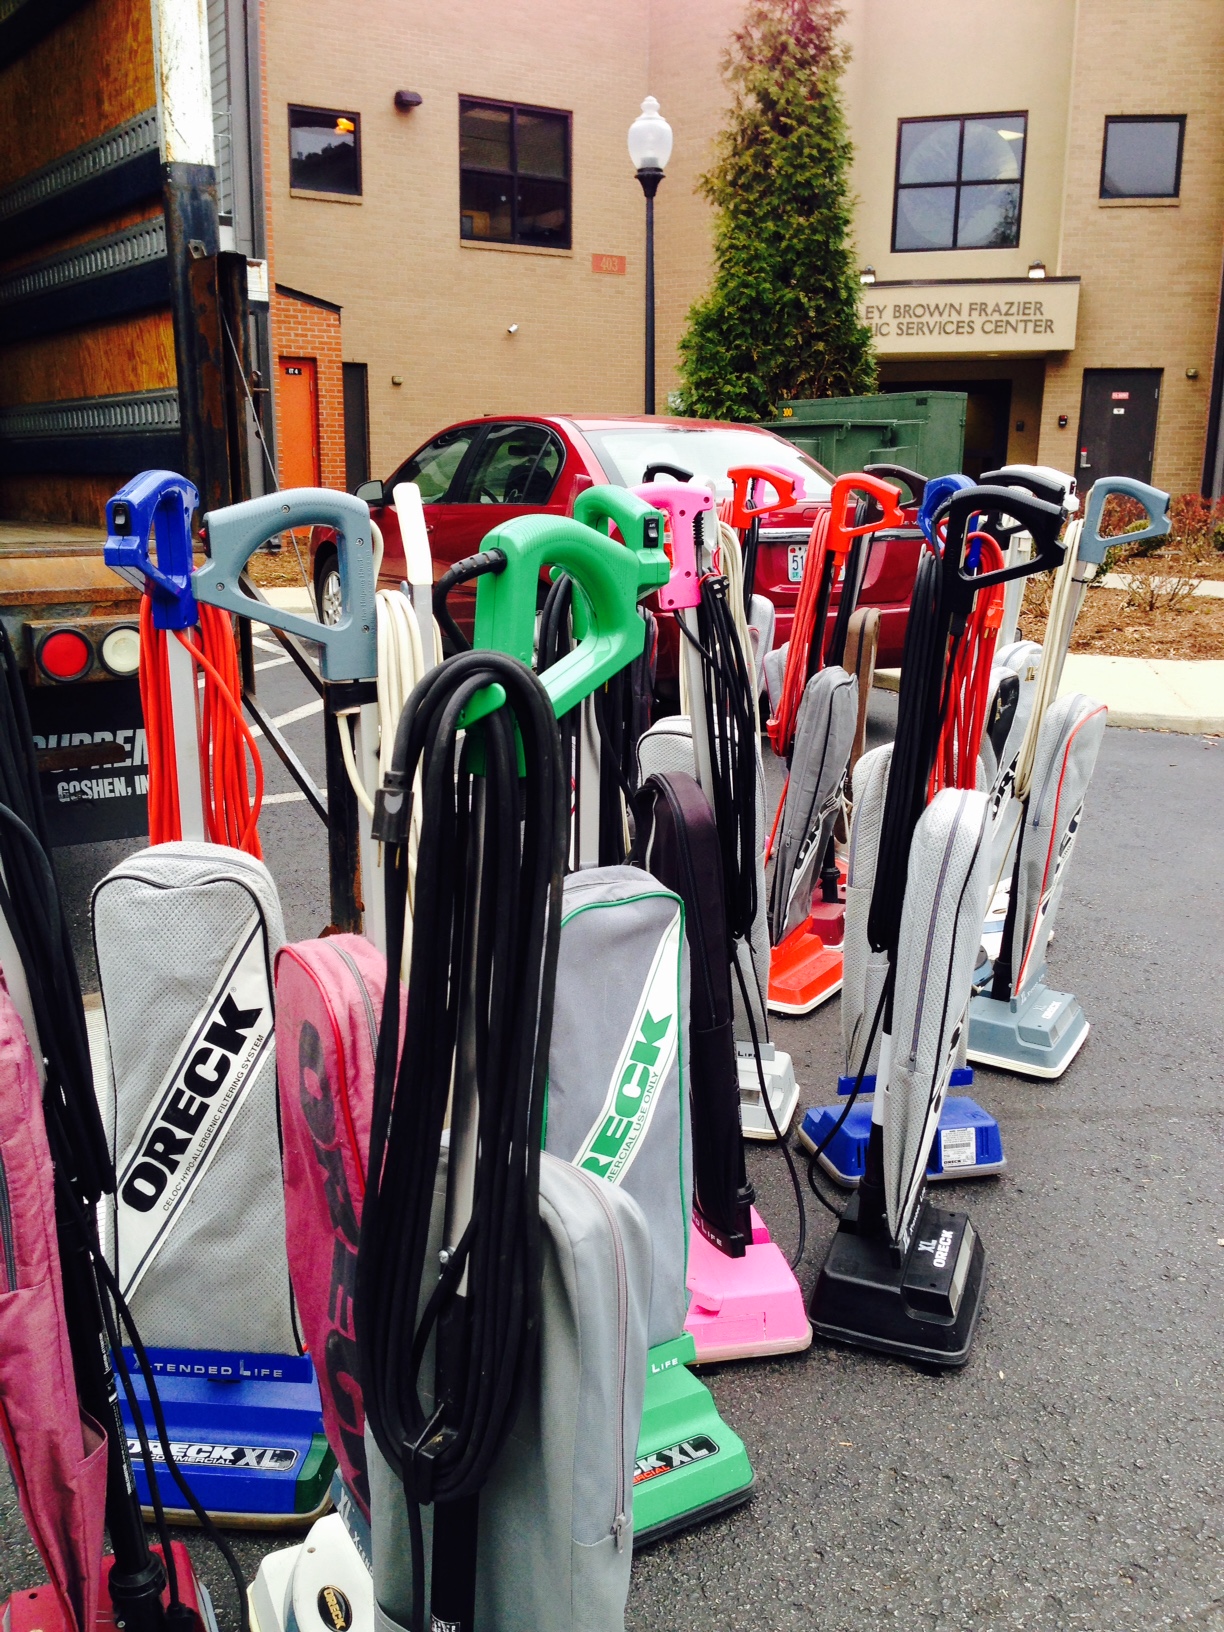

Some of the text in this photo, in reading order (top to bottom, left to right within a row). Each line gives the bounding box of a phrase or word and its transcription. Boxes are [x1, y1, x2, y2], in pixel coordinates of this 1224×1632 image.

[600, 256, 618, 271] 403
[865, 301, 1044, 320] EY BROWN FRAZIER
[874, 319, 1055, 337] IC SERVICES CENTER
[783, 407, 793, 417] 300
[792, 554, 805, 571] 51
[57, 777, 132, 802] GOSHEN,
[121, 992, 264, 1213] ORECK
[580, 1008, 673, 1179] RECK
[180, 1114, 221, 1182] HYPO-ALLERGENIC
[217, 1071, 244, 1115] FILTERING
[241, 1034, 264, 1071] SYSTEM
[607, 1071, 659, 1182] MERCIAL USE ONLY
[917, 1239, 938, 1254] XL
[933, 1229, 954, 1268] ORECK
[234, 1447, 283, 1468] XL
[661, 1440, 710, 1467] XL
[323, 1587, 346, 1631] ORECK
